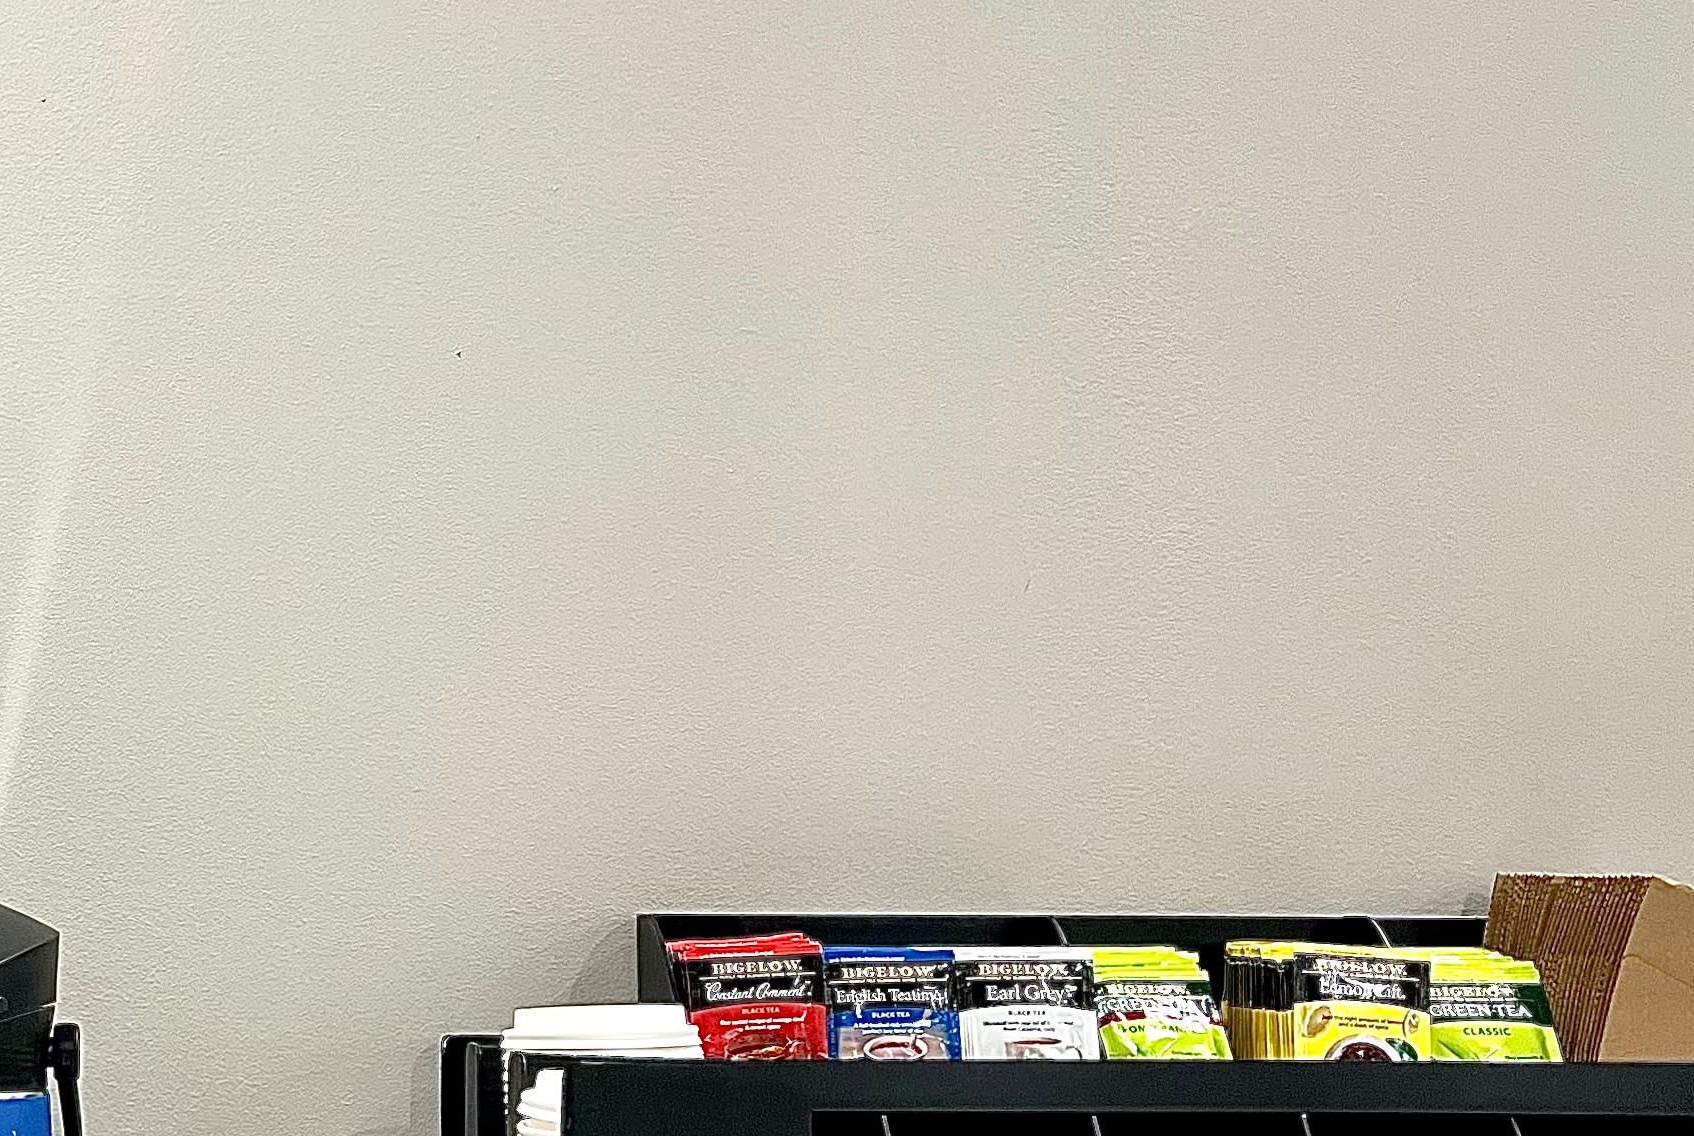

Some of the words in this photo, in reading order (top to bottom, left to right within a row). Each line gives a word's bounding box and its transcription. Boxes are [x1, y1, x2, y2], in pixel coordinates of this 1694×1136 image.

[711, 959, 803, 975] BIGELOW
[841, 966, 934, 979] BIGELOW
[835, 988, 887, 1006] English
[986, 983, 1022, 1001] Earl
[1025, 984, 1066, 1006] Grey
[741, 1007, 765, 1015] BLACK
[766, 1006, 781, 1014] TEA
[871, 1011, 895, 1019] BLACK
[1430, 1004, 1491, 1018] GREEN
[1492, 1004, 1533, 1018] TEA
[1463, 1027, 1512, 1036] CLASSIC
